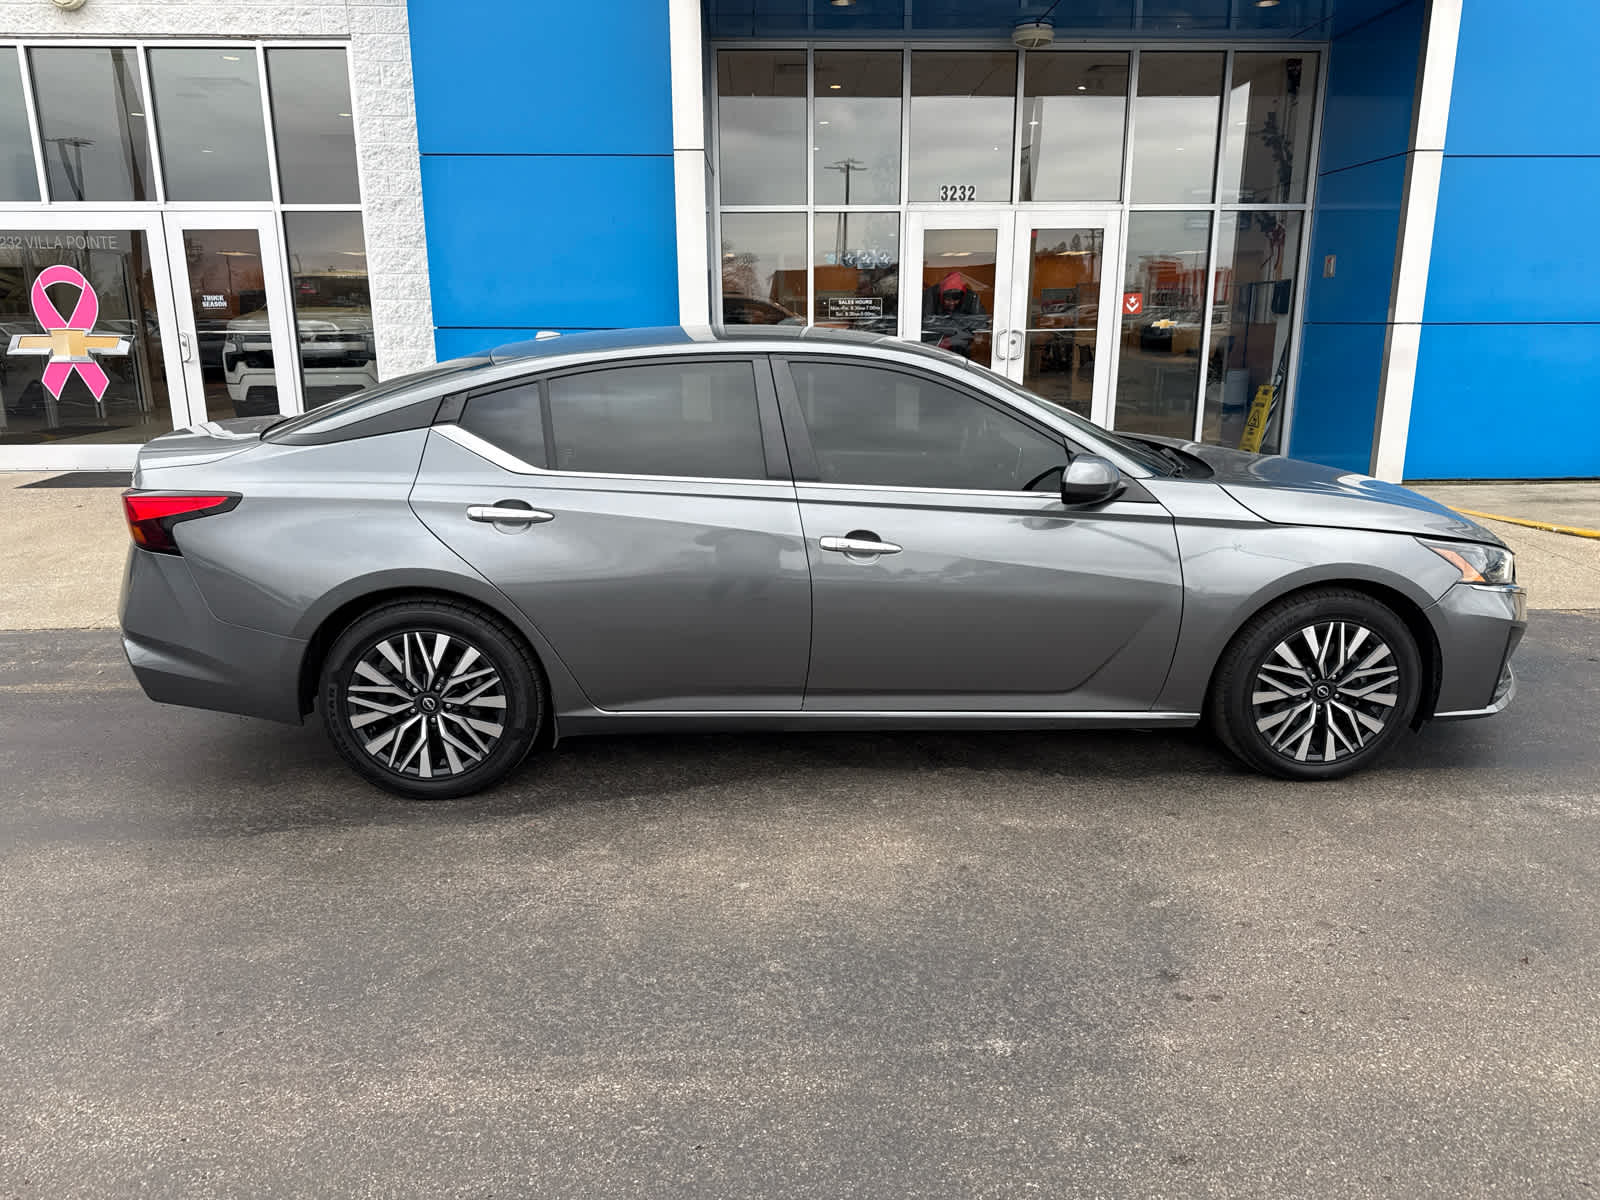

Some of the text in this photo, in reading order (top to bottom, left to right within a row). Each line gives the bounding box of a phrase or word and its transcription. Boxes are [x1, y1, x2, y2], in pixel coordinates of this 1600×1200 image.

[941, 185, 975, 201] 3232
[24, 235, 63, 249] VILLA
[66, 235, 117, 249] POINTE
